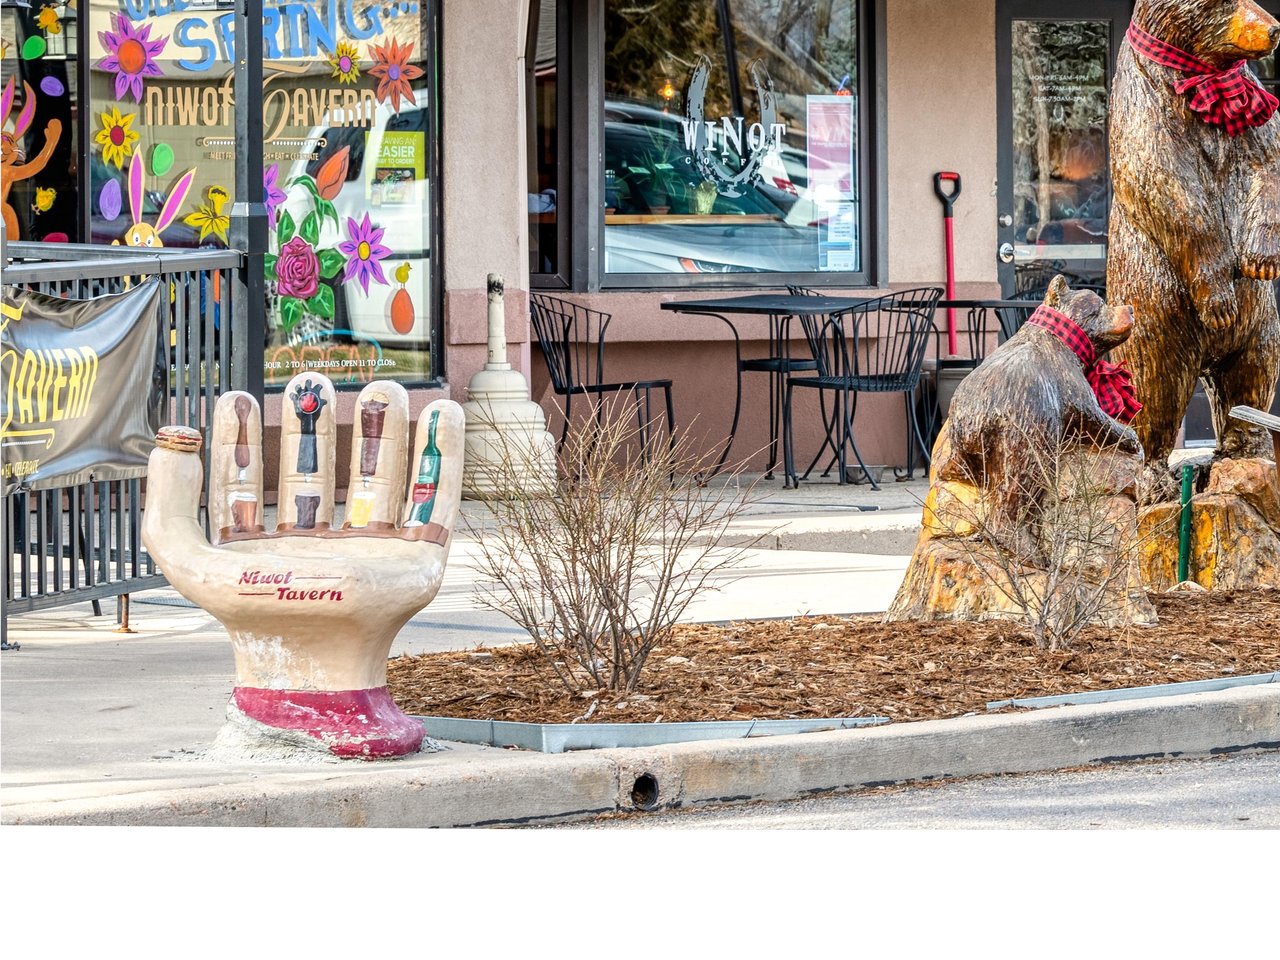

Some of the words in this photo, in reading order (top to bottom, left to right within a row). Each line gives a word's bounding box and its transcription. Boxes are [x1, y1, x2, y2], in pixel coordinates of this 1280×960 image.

[681, 117, 786, 156] WINOT
[377, 146, 415, 158] EASIER
[291, 360, 300, 368] TO
[341, 359, 358, 368] OPEN
[367, 358, 376, 367] TO
[239, 571, 292, 584] Niwot
[277, 587, 343, 601] Tavern
